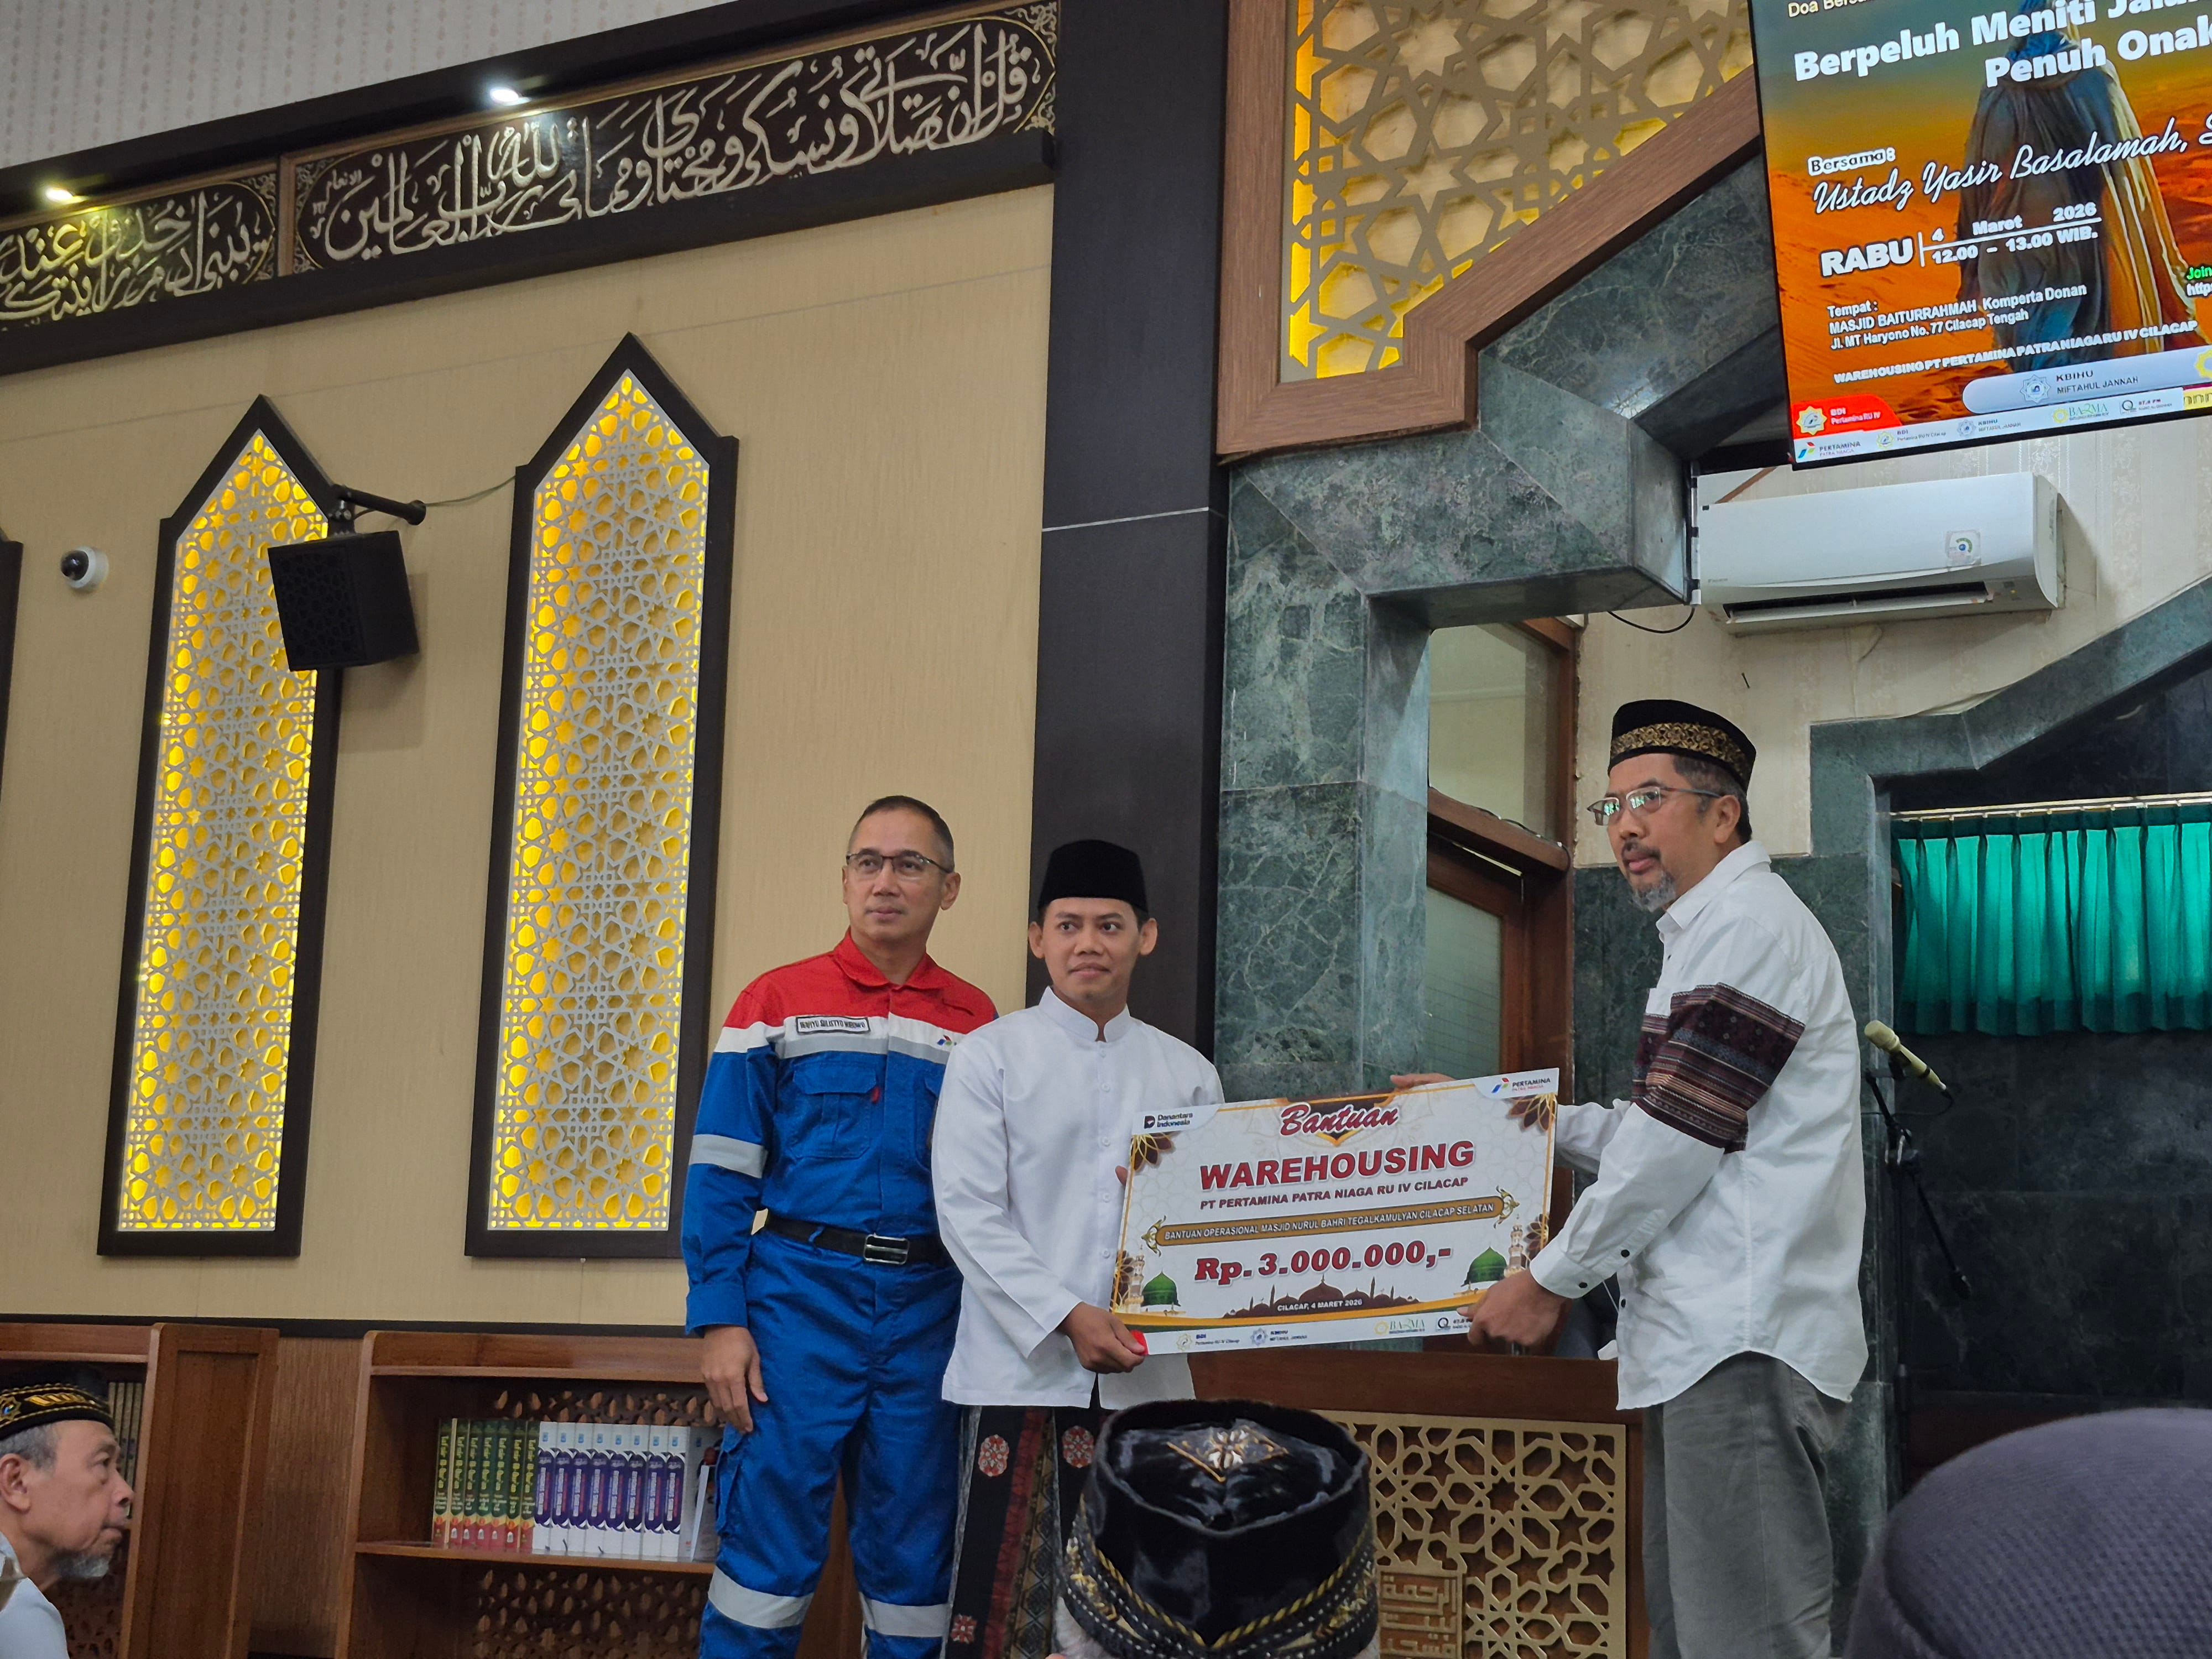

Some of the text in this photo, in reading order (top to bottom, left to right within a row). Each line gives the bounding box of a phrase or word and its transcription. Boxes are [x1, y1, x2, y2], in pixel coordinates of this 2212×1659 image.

[1788, 1, 1819, 17] Doa
[1794, 0, 2096, 81] Berpeluh Meniti
[1985, 38, 2106, 88] Penuh
[1814, 168, 1914, 213] Ustadz
[1922, 160, 2002, 203] Yasir
[2010, 117, 2188, 179] Basalamah,
[1932, 202, 2097, 242] 4 Maret 2026
[1821, 238, 1914, 276] RABU
[1932, 244, 1978, 264] 12.00
[2005, 233, 2053, 252] 13.00
[2187, 266, 2212, 280] Join
[2187, 281, 2212, 296] http
[1827, 300, 1871, 319] Tempat
[1829, 284, 2087, 335] MASJID BAITURRAHMAH Komperta Donan
[1845, 335, 1861, 347] MT
[1864, 329, 1910, 345] Haryono
[1911, 325, 1929, 337] No.
[1930, 322, 1943, 333] 77
[1945, 318, 1986, 333] Cilacap
[1986, 309, 2029, 326] Tengah
[1834, 320, 2198, 384] WAREHOUSING PT PERTAMINA PATRA NIAGA RU IV CILACAP
[2056, 370, 2094, 382] KBIHU
[2057, 376, 2139, 394] MIFTAHUL JANNAH
[1830, 408, 1846, 416] BDI
[1830, 415, 1863, 425] Pertamina
[1819, 441, 1861, 451] PERTAMINA
[1512, 1078, 1551, 1087] PERTAMINA
[1280, 1103, 1399, 1136] Bantuan
[1200, 1140, 1474, 1190] WAREHOUSING
[1200, 1177, 1469, 1210] PT PERTAMINA PATRA NIAGA RU IV CILACAP
[1165, 1203, 1494, 1240] BANTUAN OPERASIONAL MASJID NURUL BAHRI TEGALKAMULYAN CILACAP SELATAN
[1194, 1240, 1451, 1285] Rp. 3.000.000,-
